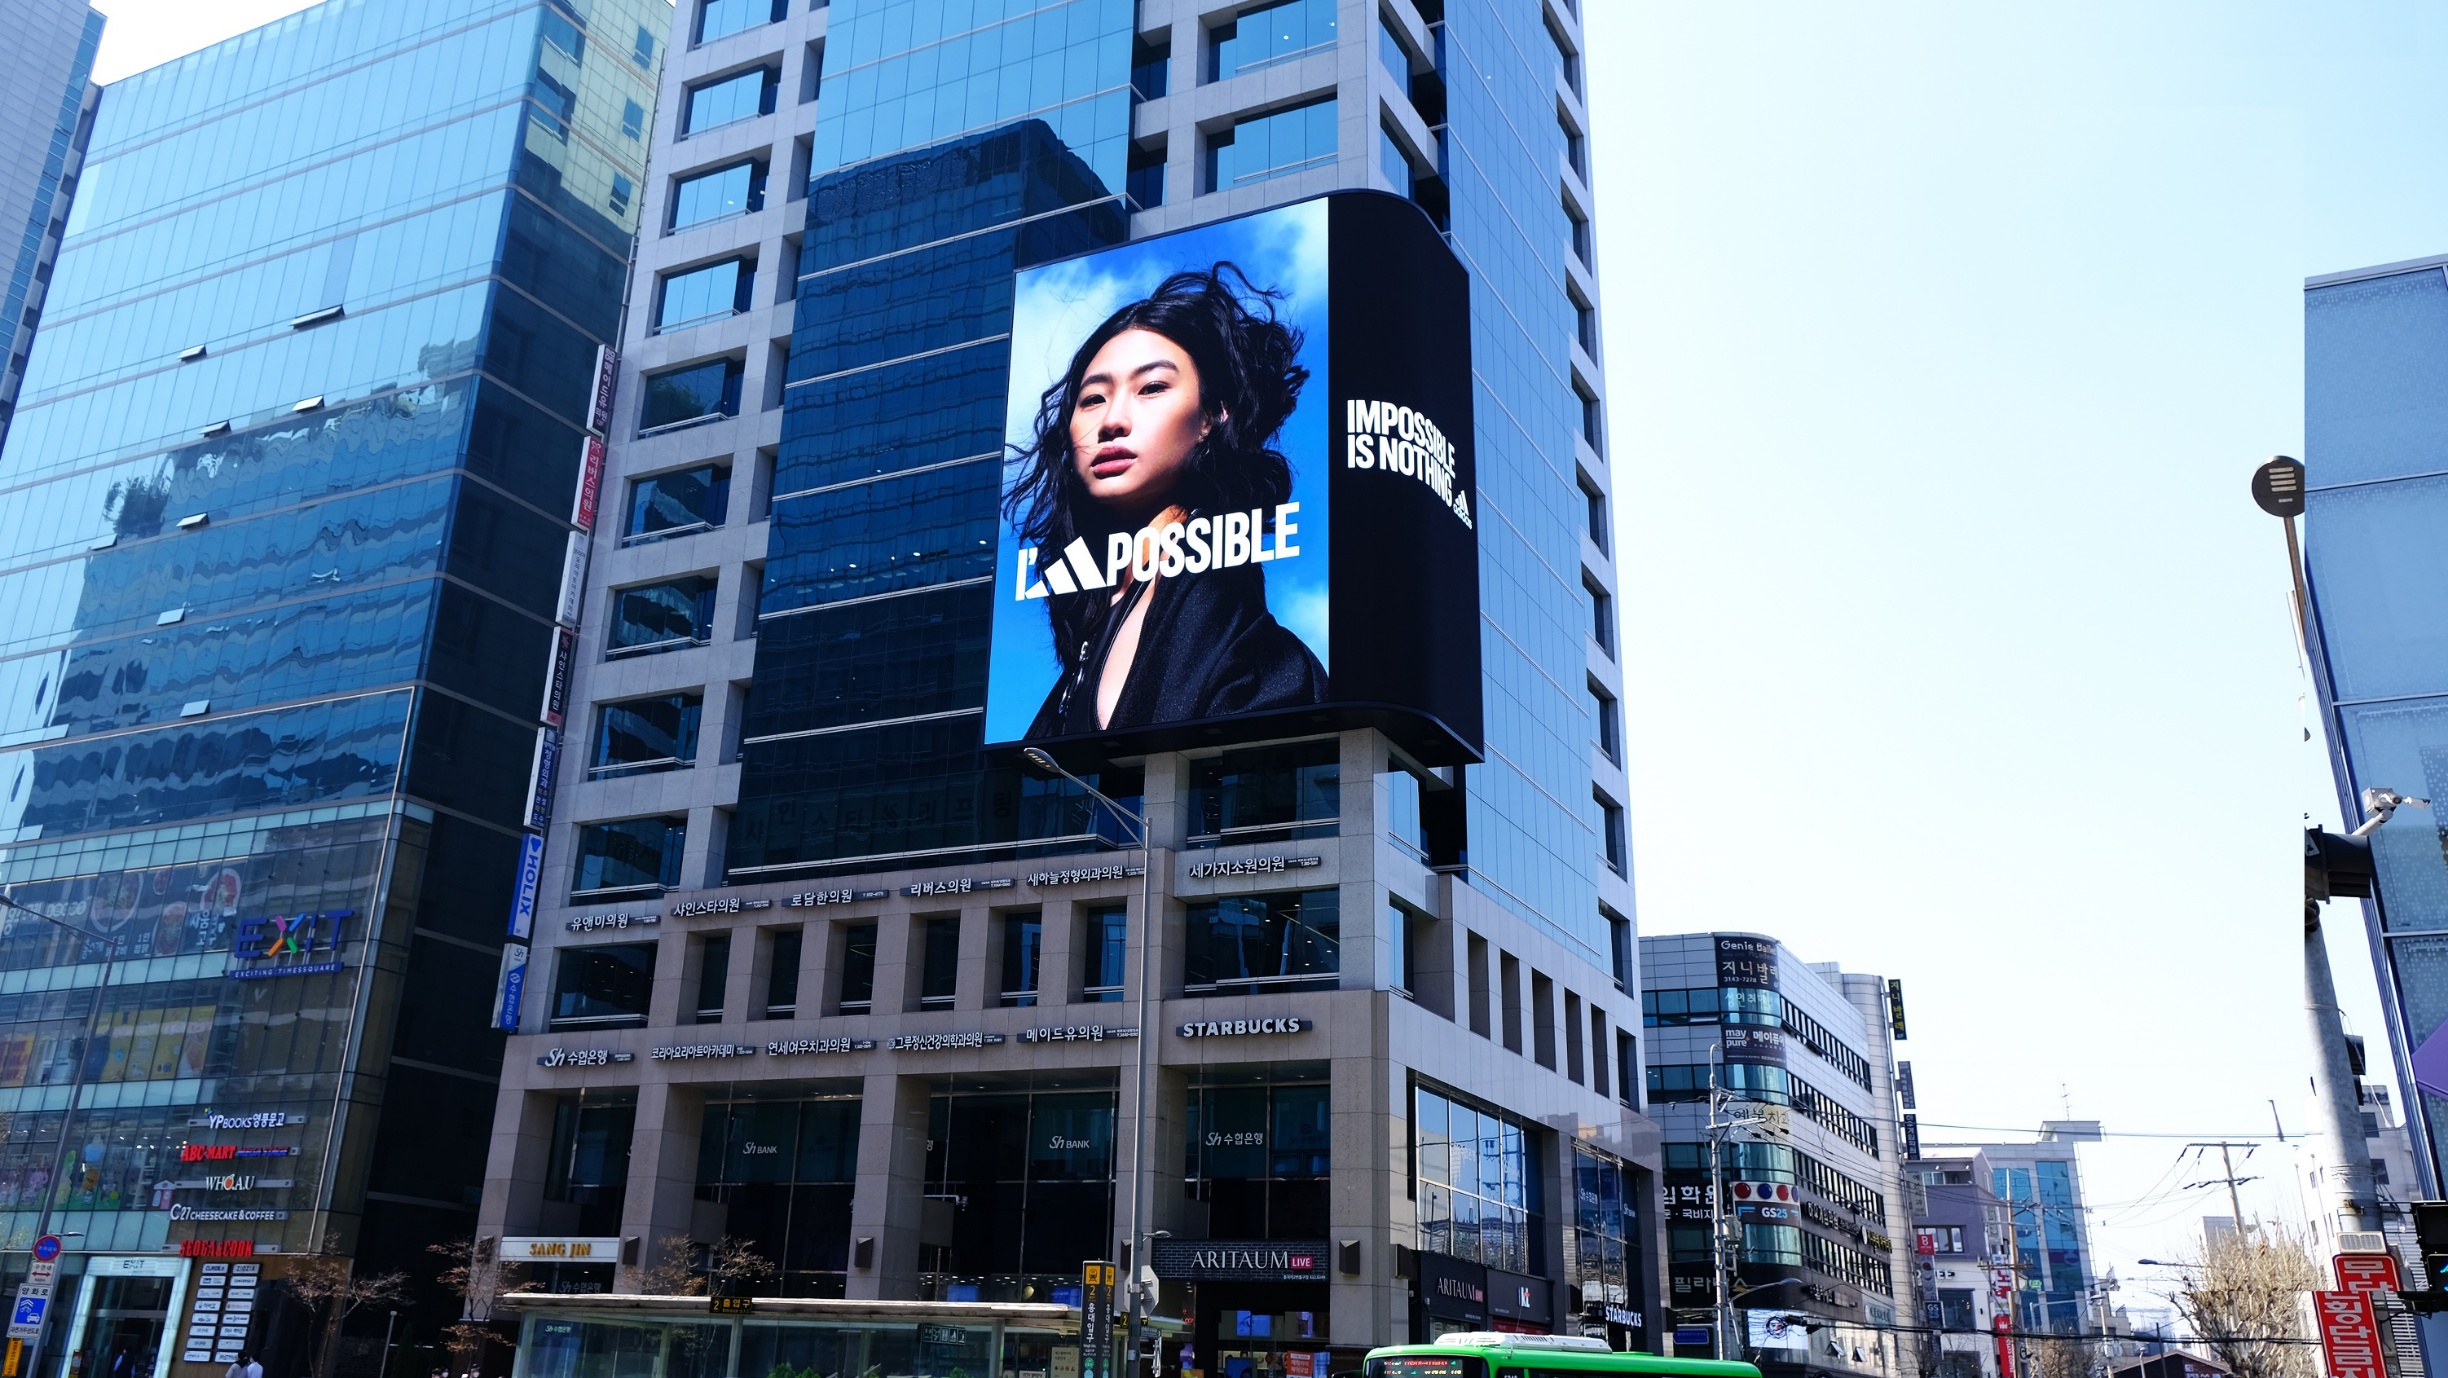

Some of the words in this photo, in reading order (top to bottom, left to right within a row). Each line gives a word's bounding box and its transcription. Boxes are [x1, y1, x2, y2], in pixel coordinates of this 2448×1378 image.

[1347, 399, 1456, 479] IMPOSSIBLE
[1347, 435, 1375, 469] IS
[1378, 439, 1453, 508] NOTHING
[1027, 865, 1123, 886] 새하늘정형외과의원
[1190, 856, 1286, 878] 세가지소원의원
[519, 855, 539, 917] HOLIX
[910, 878, 972, 897] 리버스의원
[791, 889, 853, 907] 로담한의원
[673, 898, 741, 917] 샤인스타의원
[571, 913, 629, 932] 유앤미의원
[234, 910, 354, 958] EXIT
[1721, 941, 1754, 951] Genie
[1026, 1024, 1104, 1042] 메이드유의원
[1183, 1017, 1300, 1038] STARBUCKS
[1726, 1029, 1747, 1039] may
[768, 1037, 850, 1056] 연세여우치과의원
[895, 1032, 983, 1051] 그루정신건강의학과의원
[1726, 1040, 1748, 1049] pure
[545, 1048, 565, 1067] Sh
[567, 1050, 608, 1066] 수협은행
[651, 1044, 735, 1060] 코리아요리아트아카데미
[743, 1141, 756, 1154] Sh
[757, 1145, 778, 1154] BANK
[1049, 1135, 1064, 1149] Sh
[1066, 1140, 1090, 1149] BANK
[1205, 1132, 1222, 1146] Sh
[1223, 1132, 1263, 1145] 수협은행
[181, 1145, 237, 1161] ABC-MART
[1761, 1207, 1788, 1219] GS25
[180, 1240, 253, 1257] SEOGA&COOK
[529, 1243, 566, 1257] SANG
[569, 1243, 591, 1258] JIN
[1191, 1250, 1289, 1269] ARITAUM
[1292, 1258, 1311, 1267] LIVE
[21, 1287, 49, 1296] 양화로
[1089, 1285, 1096, 1296] 2
[1107, 1286, 1111, 1297] 2
[1437, 1277, 1476, 1301] ARITAUM
[713, 1300, 720, 1310] 2
[1086, 1302, 1096, 1343] 홍대입구
[1605, 1306, 1642, 1328] STARBUCKS
